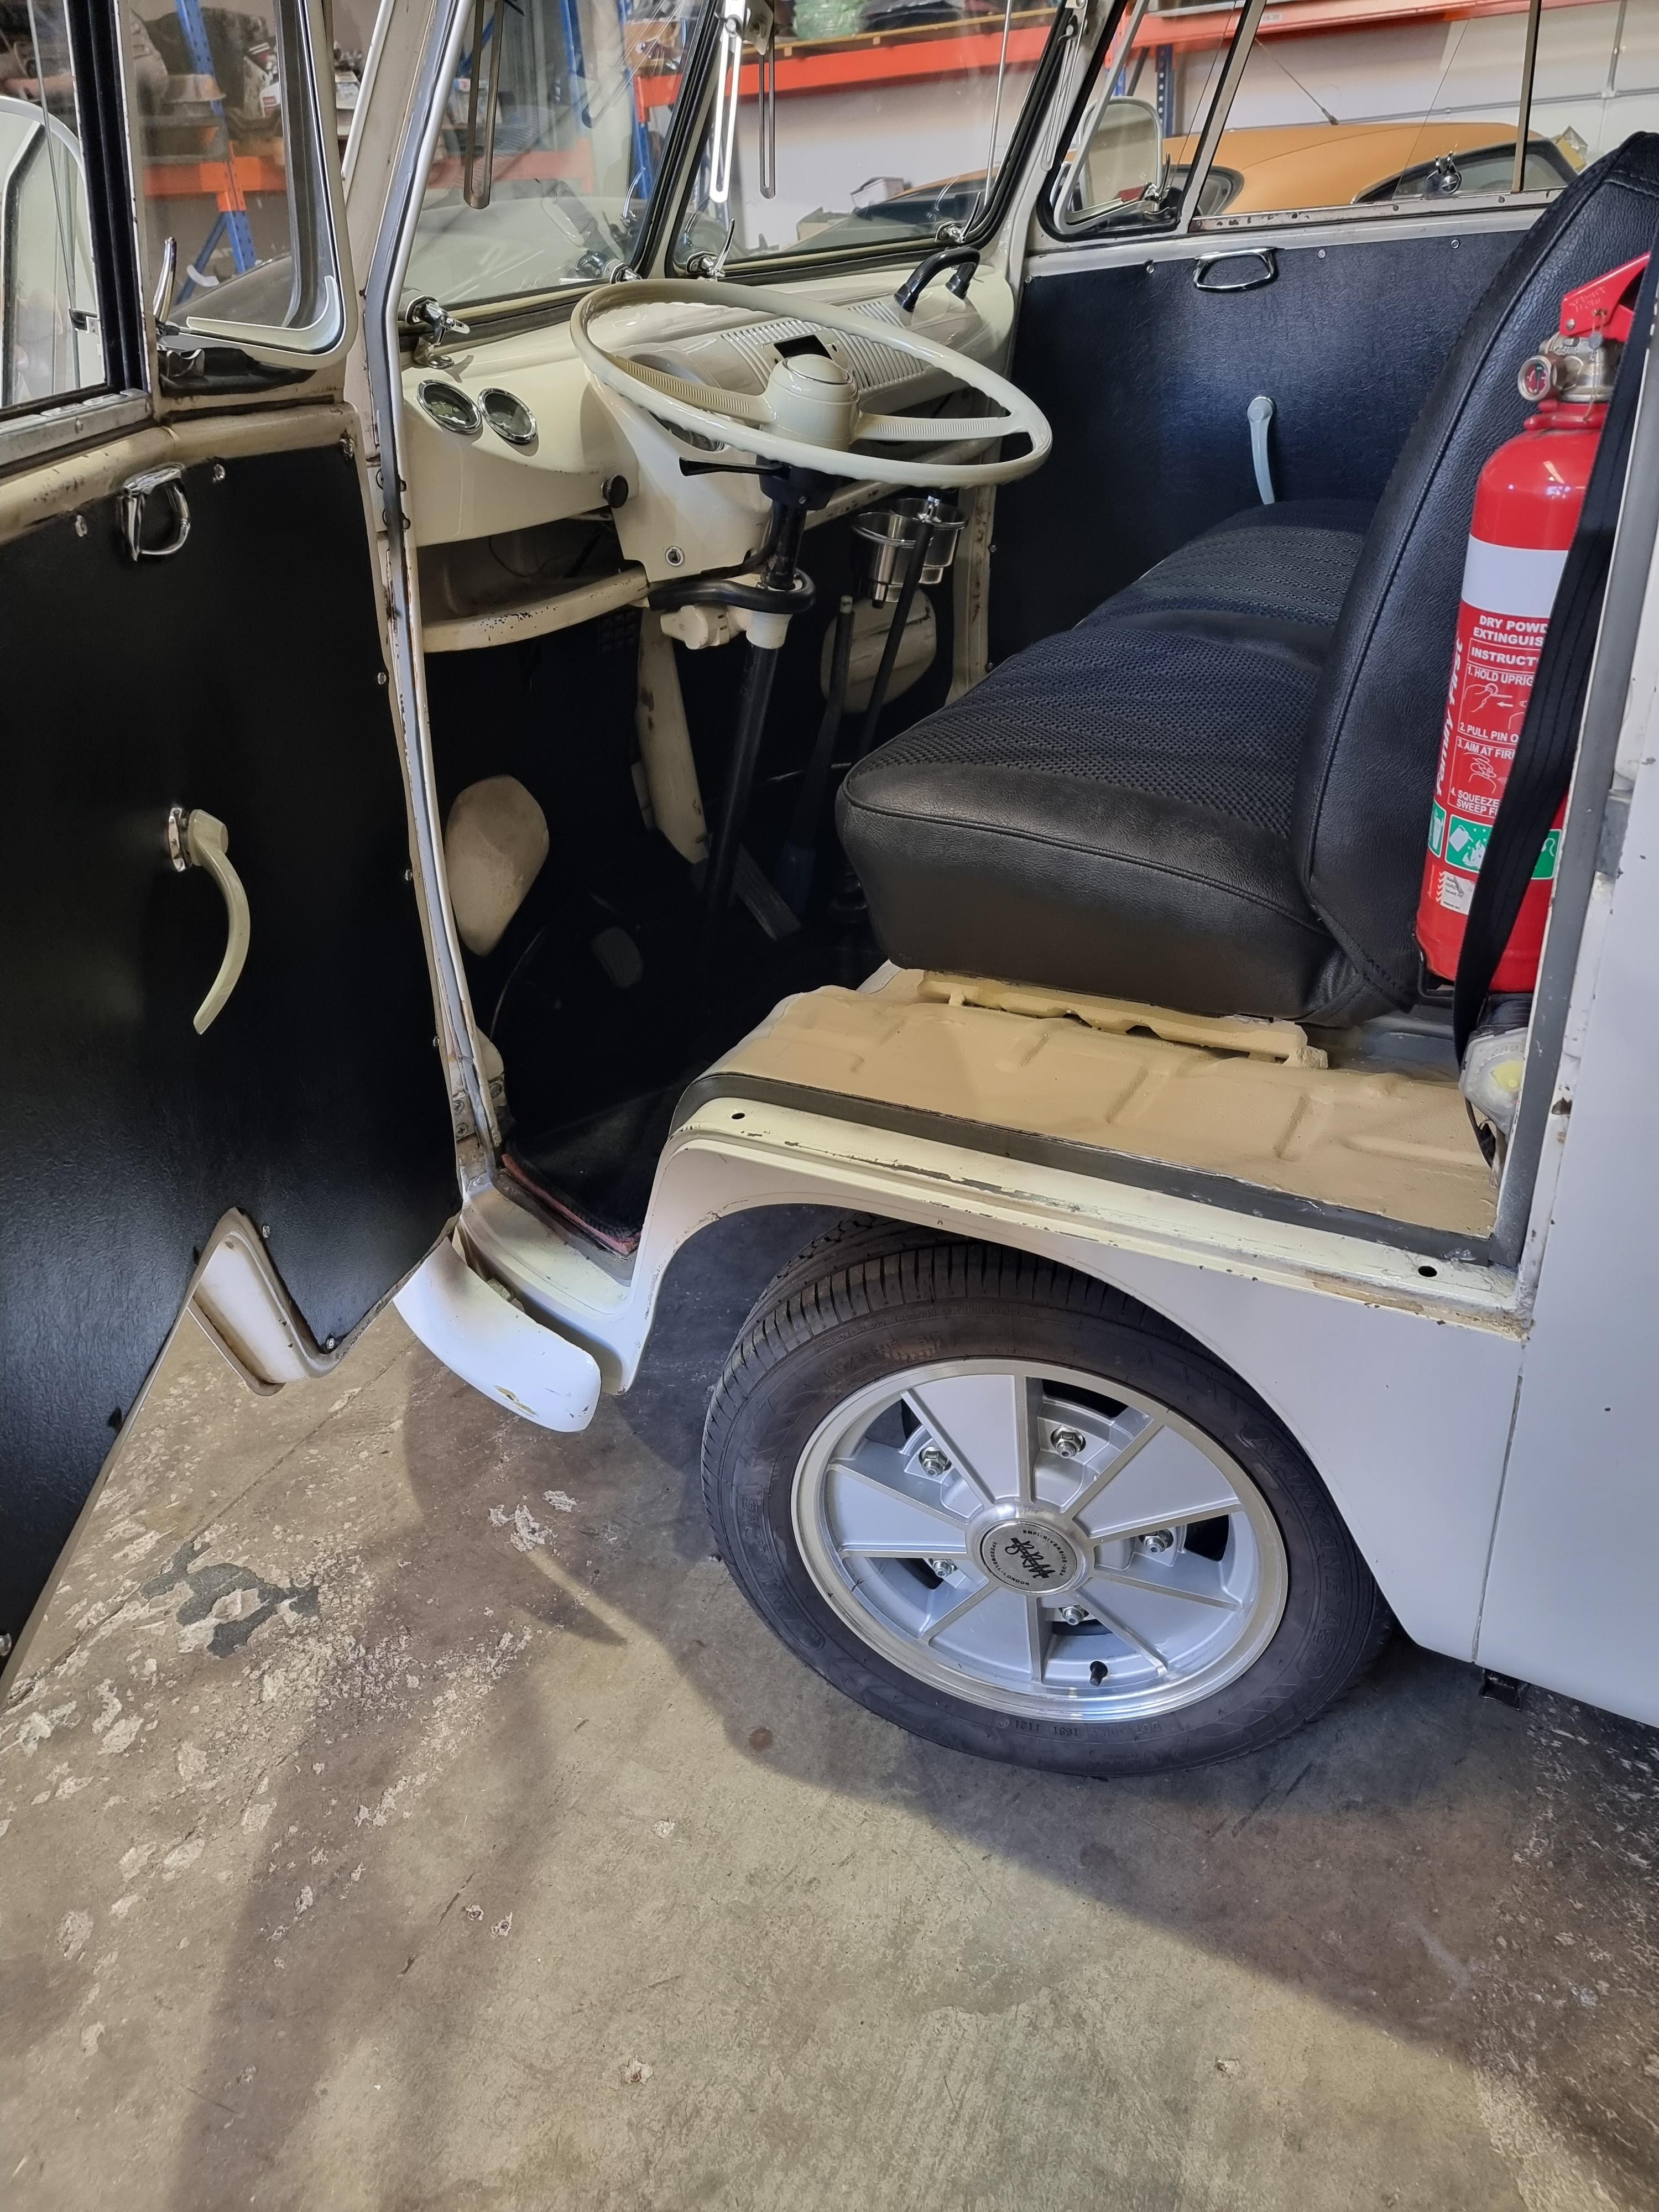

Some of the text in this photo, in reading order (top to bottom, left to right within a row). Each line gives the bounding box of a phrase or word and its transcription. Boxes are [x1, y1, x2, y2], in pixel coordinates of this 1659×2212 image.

[1479, 615, 1503, 629] DRY
[1473, 627, 1545, 646] EXTINGUIS
[1467, 666, 1534, 686] 1. HOLD UPRIG
[1459, 722, 1465, 731] 2.
[1467, 724, 1489, 738] PULL
[1490, 731, 1507, 742] PIN
[1457, 738, 1463, 748] 3.
[1464, 742, 1479, 753] AIM
[1480, 747, 1493, 757] AT
[1451, 787, 1500, 808] 4. SQUEEZE
[1456, 799, 1486, 814] SWEEP
[990, 1541, 1030, 1585] SPEEDWELL LONDON
[1042, 1535, 1067, 1563] RIVERSIDE
[1059, 1566, 1067, 1576] USA
[1014, 1720, 1040, 1733] 1121
[1053, 1726, 1078, 1736] 1681
[1135, 1721, 1161, 1735] DOT
